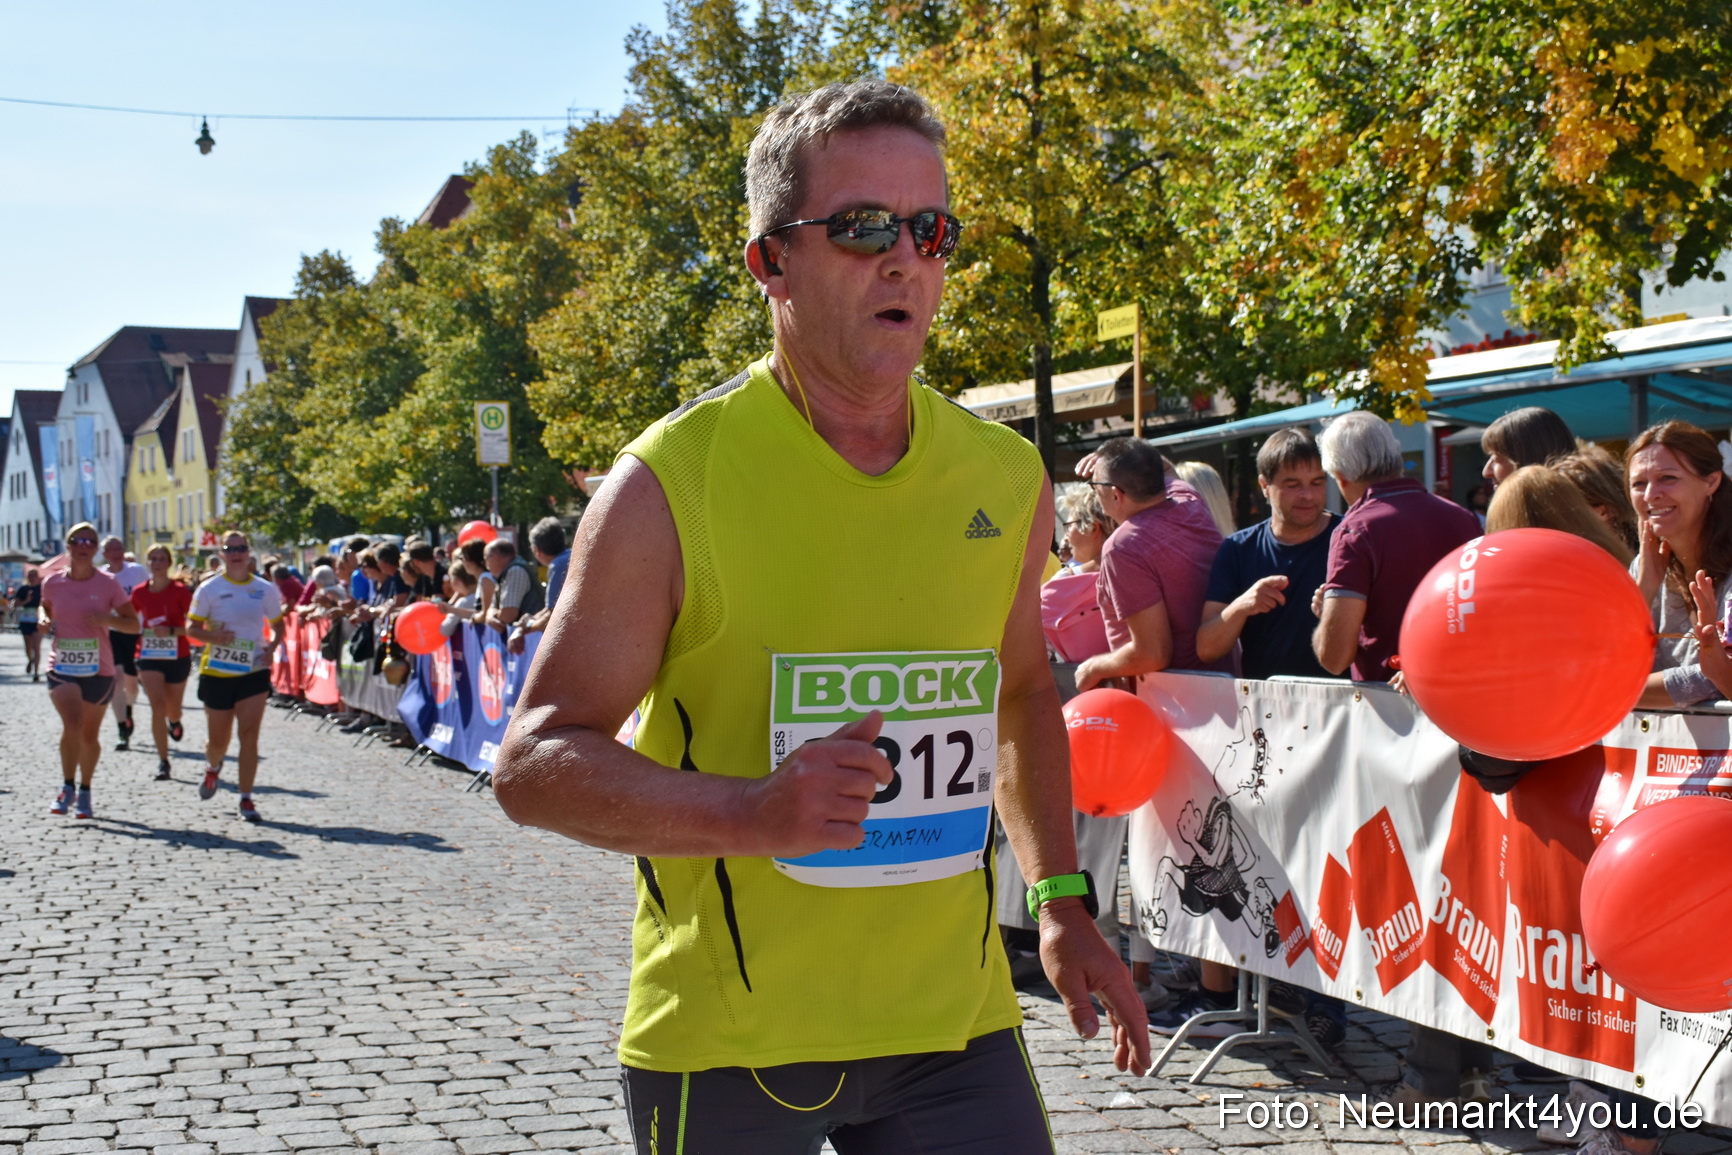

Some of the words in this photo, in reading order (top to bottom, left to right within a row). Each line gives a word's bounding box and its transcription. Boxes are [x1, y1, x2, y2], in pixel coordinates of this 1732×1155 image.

[1105, 314, 1136, 332] Toiletten
[487, 412, 499, 425] H
[965, 527, 1001, 539] adidas
[145, 639, 174, 649] 2580
[60, 652, 94, 664] 2057
[214, 647, 248, 663] 2748
[794, 661, 985, 713] BOCK
[1362, 902, 1421, 966] Braun
[1430, 872, 1499, 980] Braun
[1453, 949, 1472, 975] Sicher
[1470, 969, 1481, 985] ist
[1547, 998, 1583, 1022] Sicher
[1587, 1006, 1602, 1026] ist
[1603, 1010, 1636, 1035] sicher
[1660, 1010, 1679, 1033] Fax
